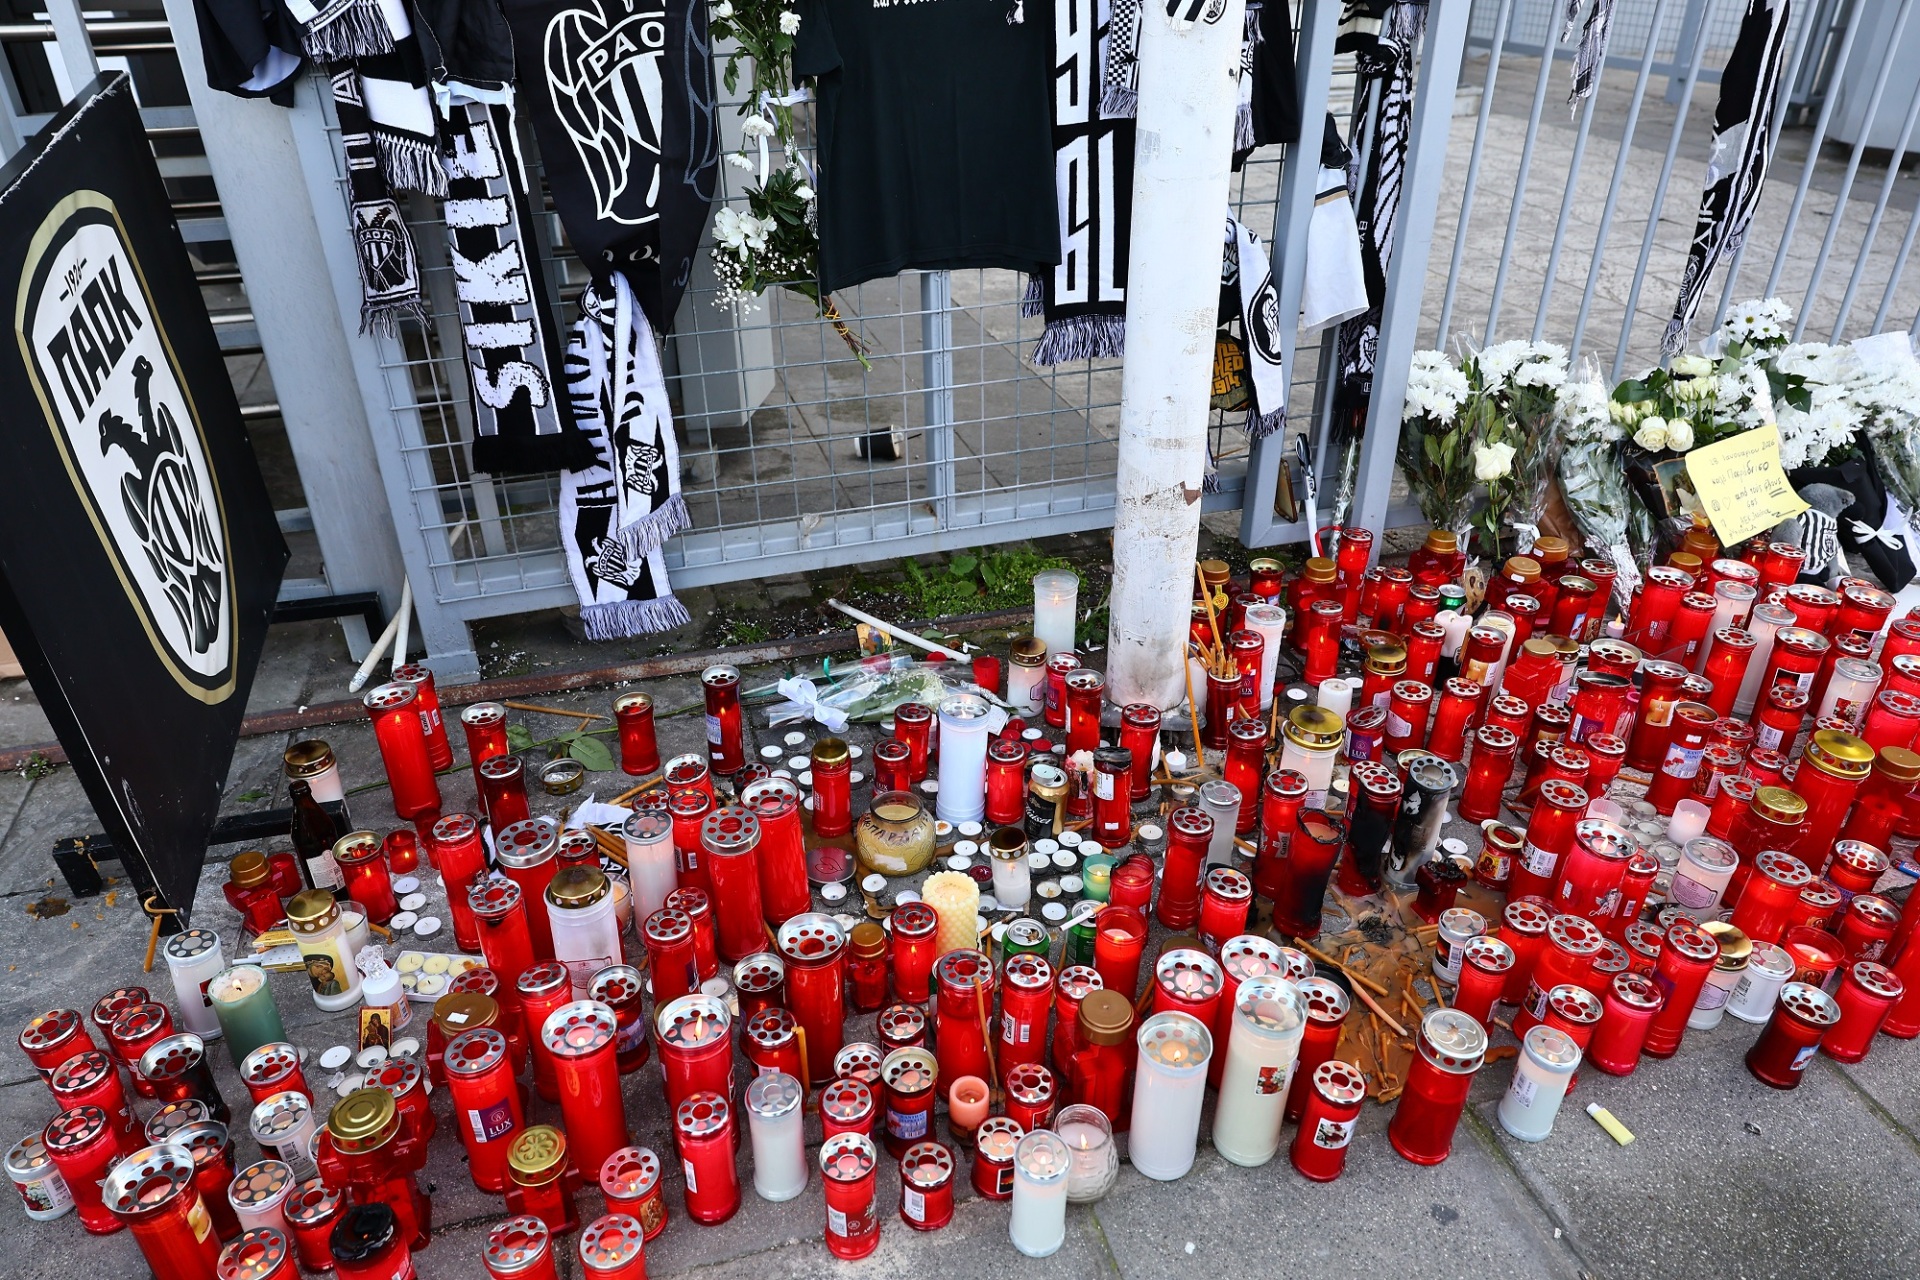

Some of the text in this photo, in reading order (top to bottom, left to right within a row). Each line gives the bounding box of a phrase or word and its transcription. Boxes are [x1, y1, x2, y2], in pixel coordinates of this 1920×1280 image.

[47, 254, 143, 424] ΠΑΟΚ
[1351, 748, 1367, 758] LUX
[489, 1117, 511, 1135] LUX
